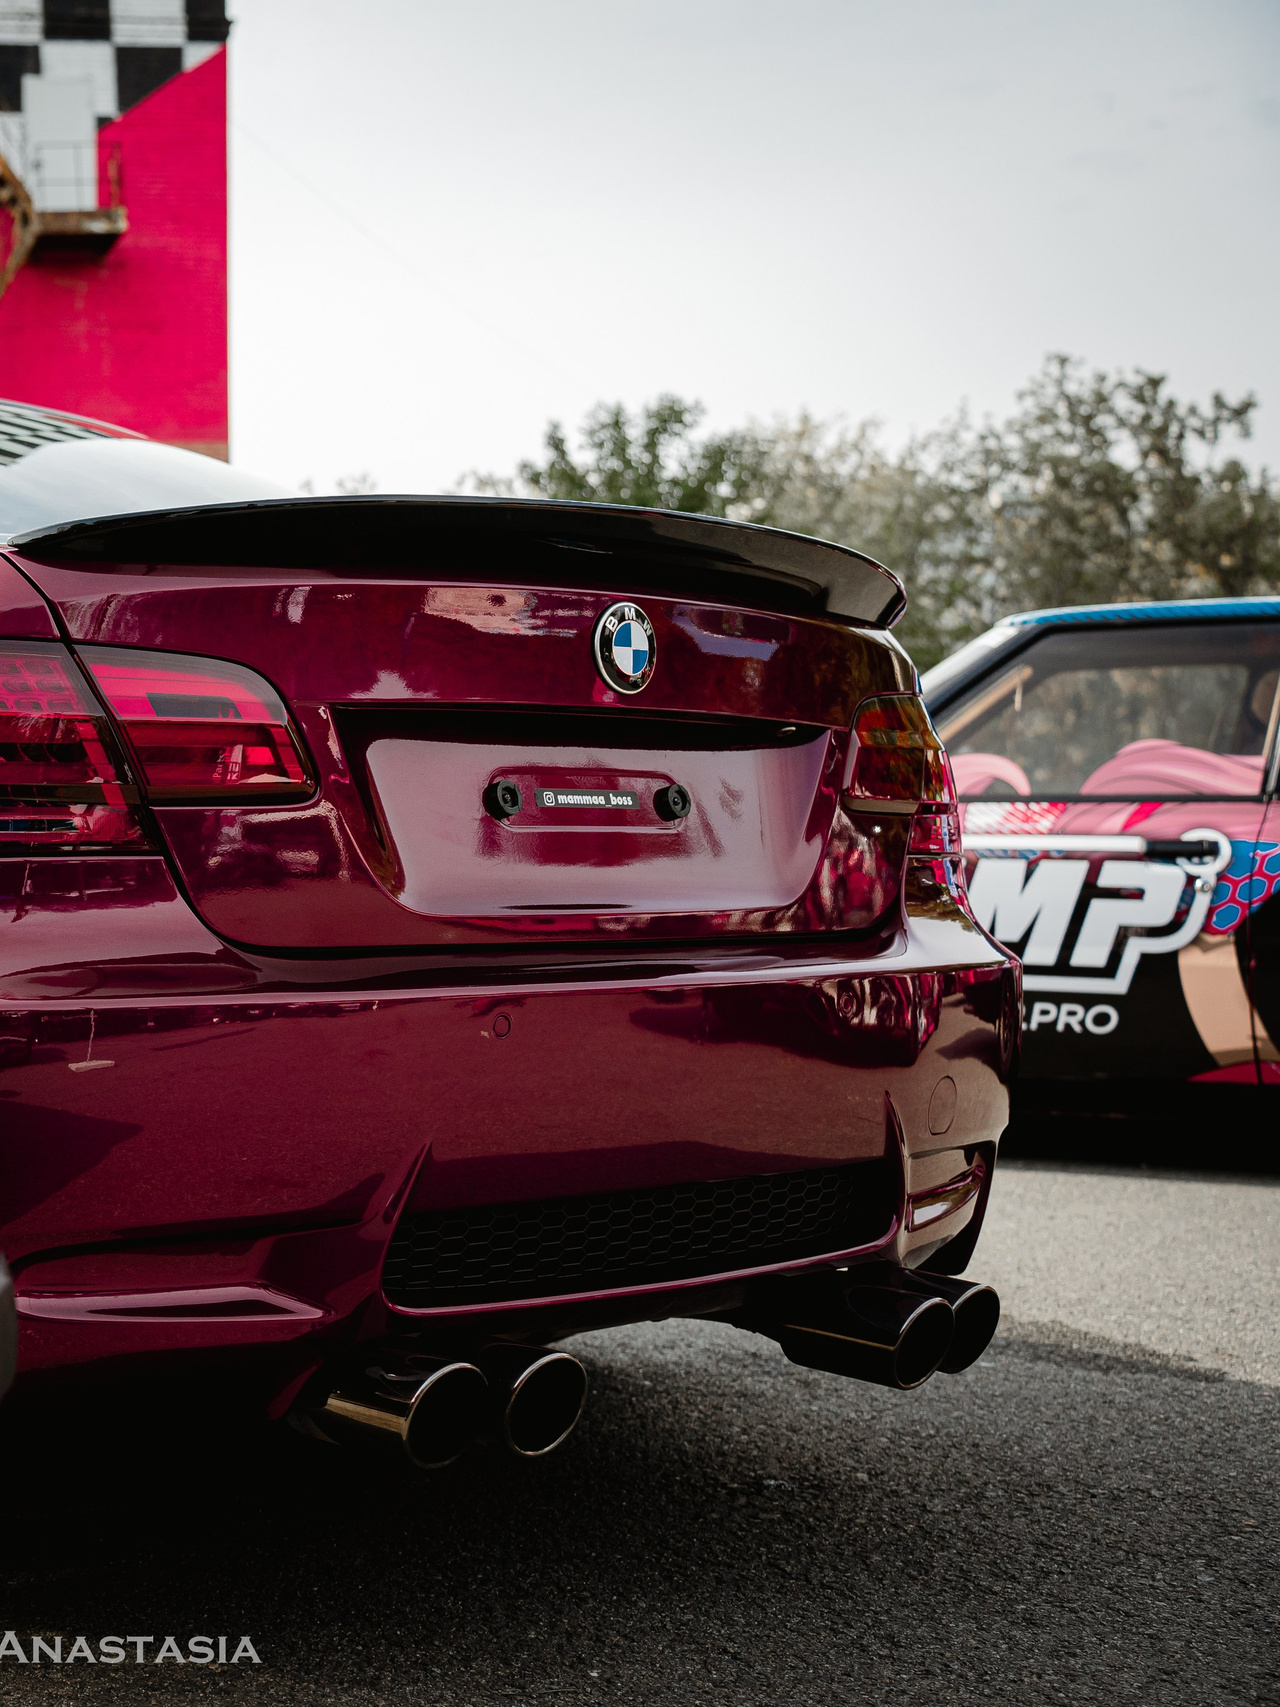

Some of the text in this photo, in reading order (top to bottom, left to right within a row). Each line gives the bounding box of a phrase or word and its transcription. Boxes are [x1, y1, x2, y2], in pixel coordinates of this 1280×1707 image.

[605, 607, 652, 637] BMW
[963, 857, 1187, 968] MP
[1021, 1001, 1119, 1035] .PRO
